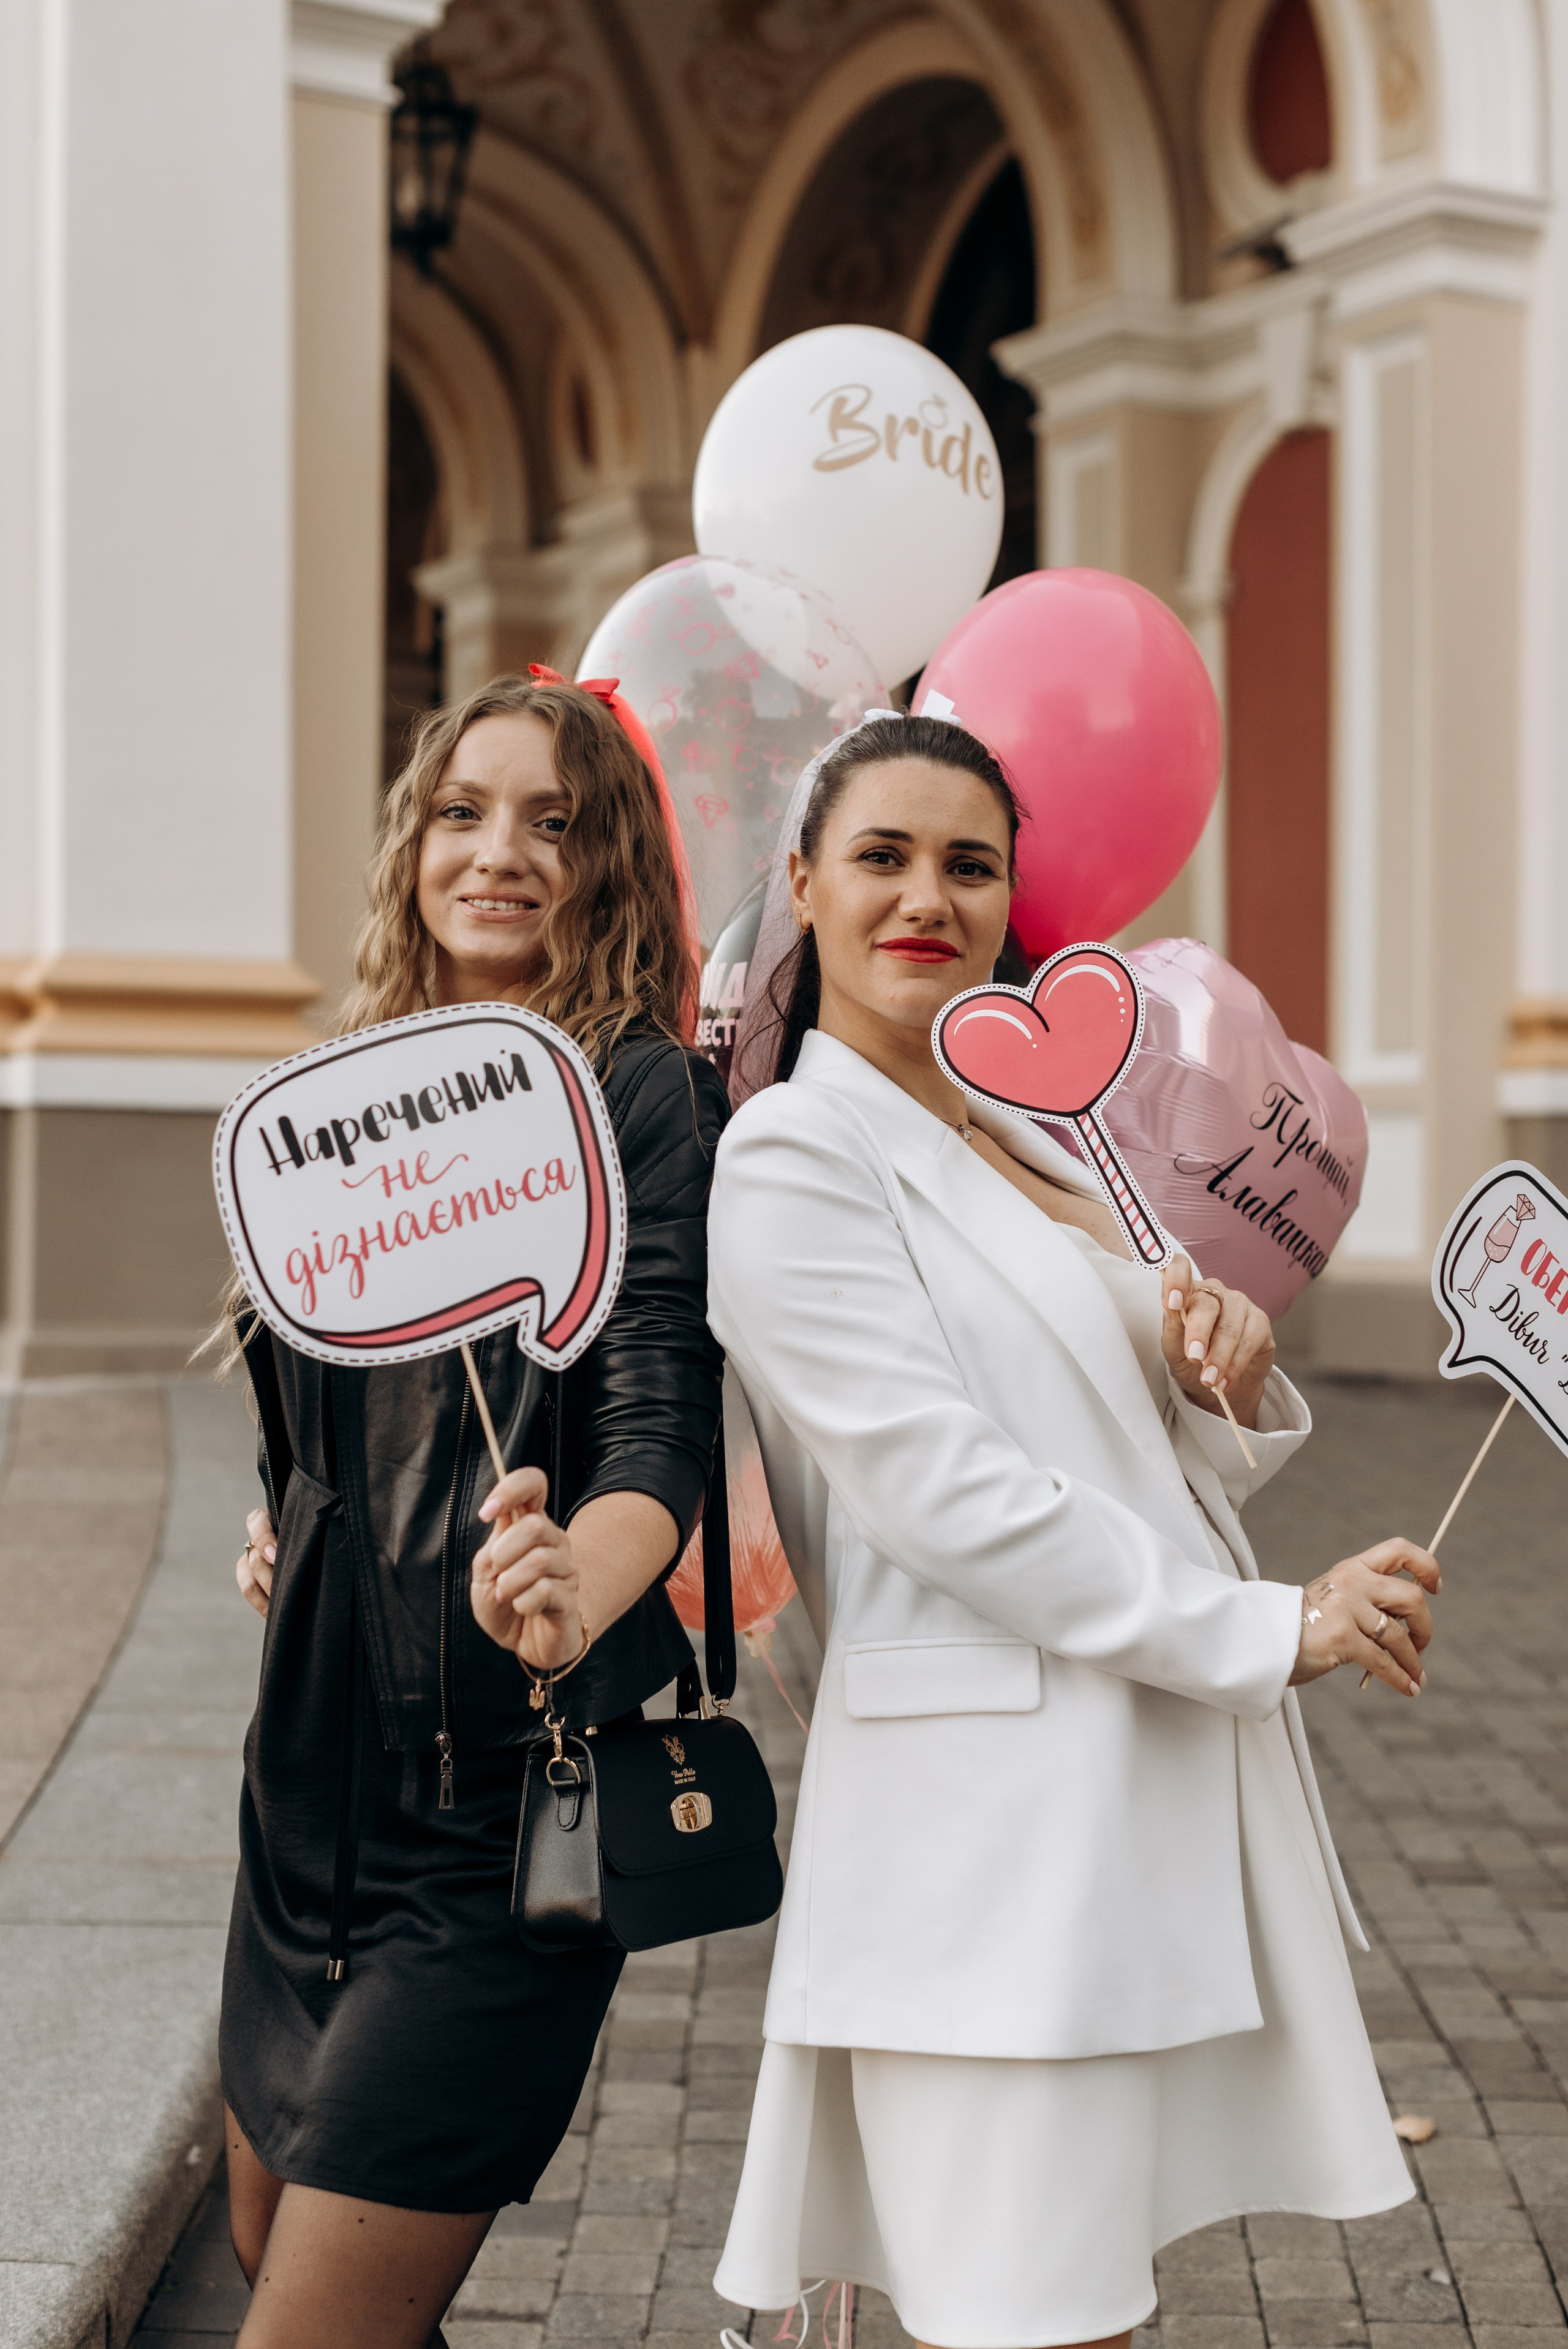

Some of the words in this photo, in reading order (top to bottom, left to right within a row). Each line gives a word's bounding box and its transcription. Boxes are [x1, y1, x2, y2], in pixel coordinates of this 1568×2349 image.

[809, 383, 993, 501] Bride
[258, 1049, 533, 1176] Наречений
[341, 1150, 469, 1198] не
[285, 1157, 576, 1316] дізнається
